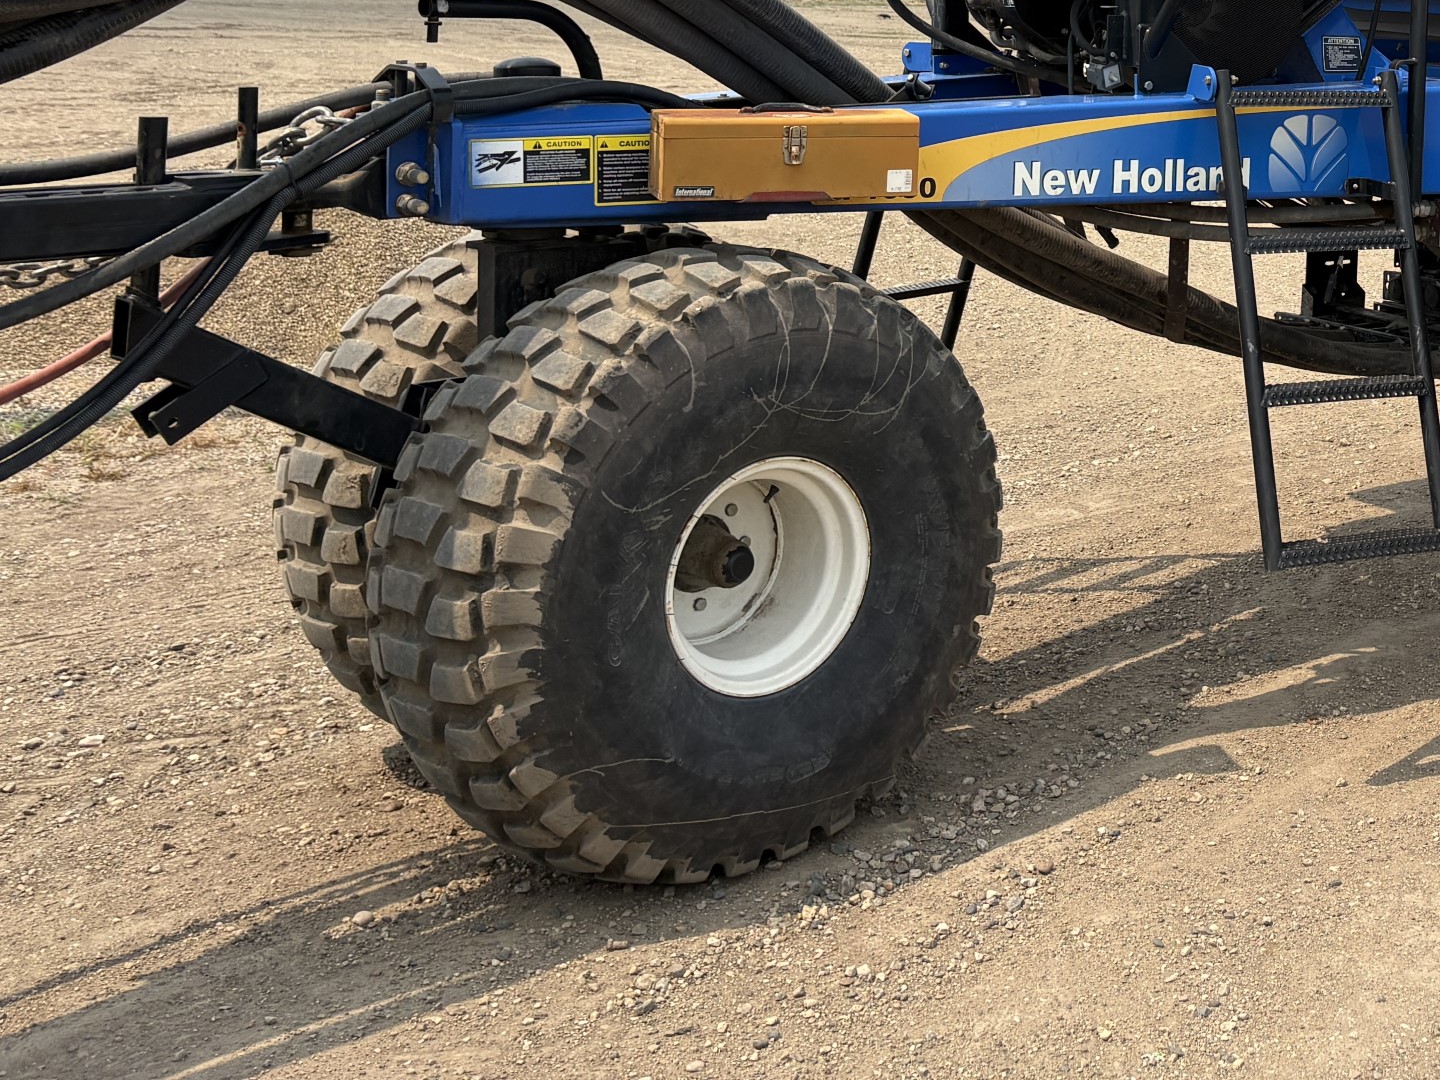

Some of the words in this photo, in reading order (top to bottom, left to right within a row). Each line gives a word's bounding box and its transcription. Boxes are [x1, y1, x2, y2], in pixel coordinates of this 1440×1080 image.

[546, 140, 582, 148] CAUTION
[1013, 161, 1100, 196] New
[676, 188, 713, 196] International
